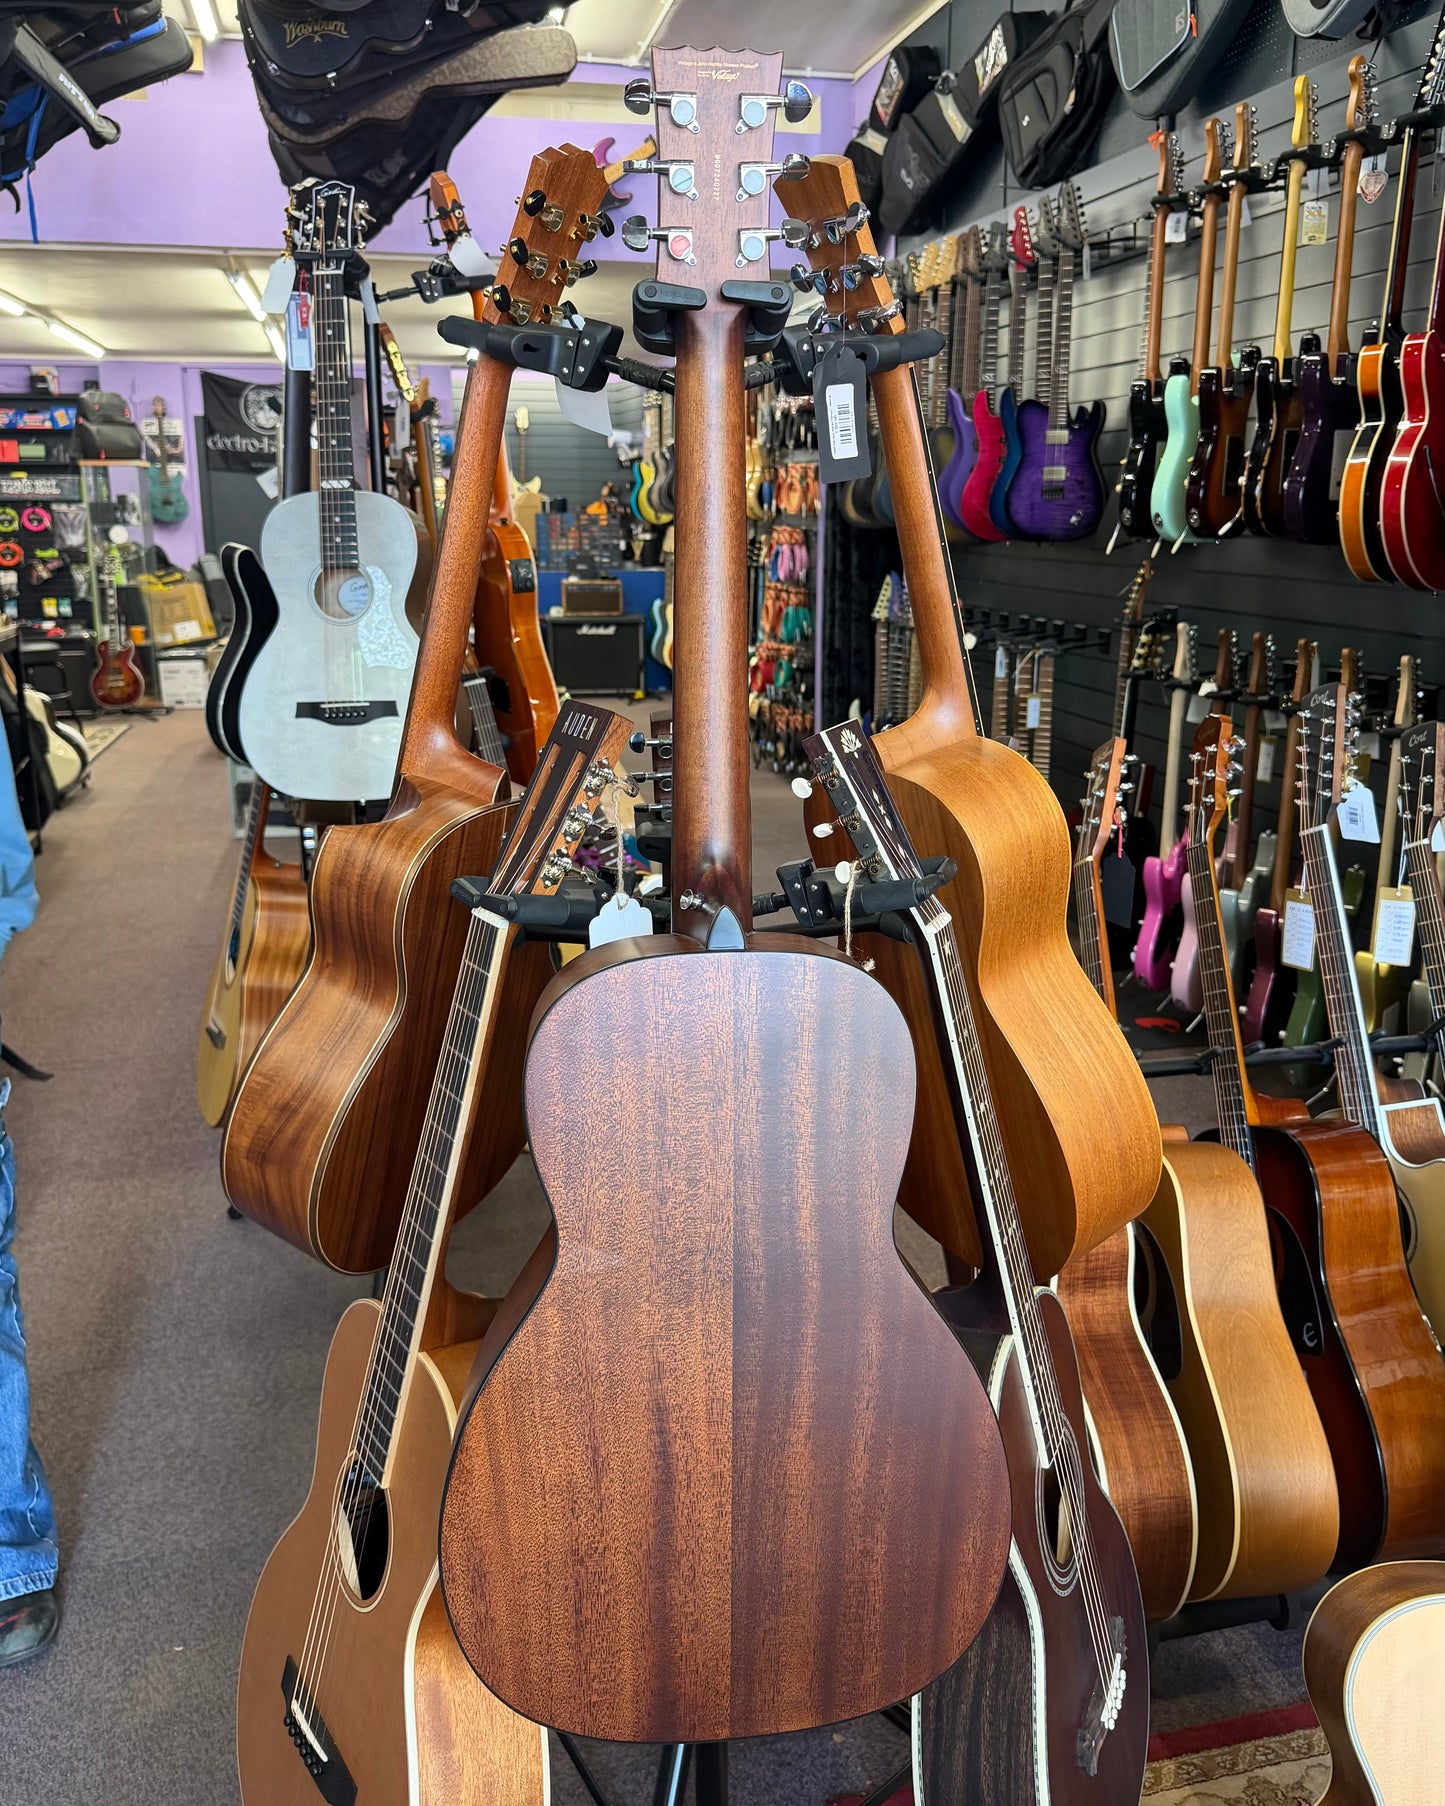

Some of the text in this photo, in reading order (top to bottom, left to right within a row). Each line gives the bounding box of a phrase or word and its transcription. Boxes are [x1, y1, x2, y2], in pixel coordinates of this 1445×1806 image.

[282, 20, 348, 43] Washburn
[1309, 690, 1329, 708] Cort
[1408, 730, 1428, 747] Cort
